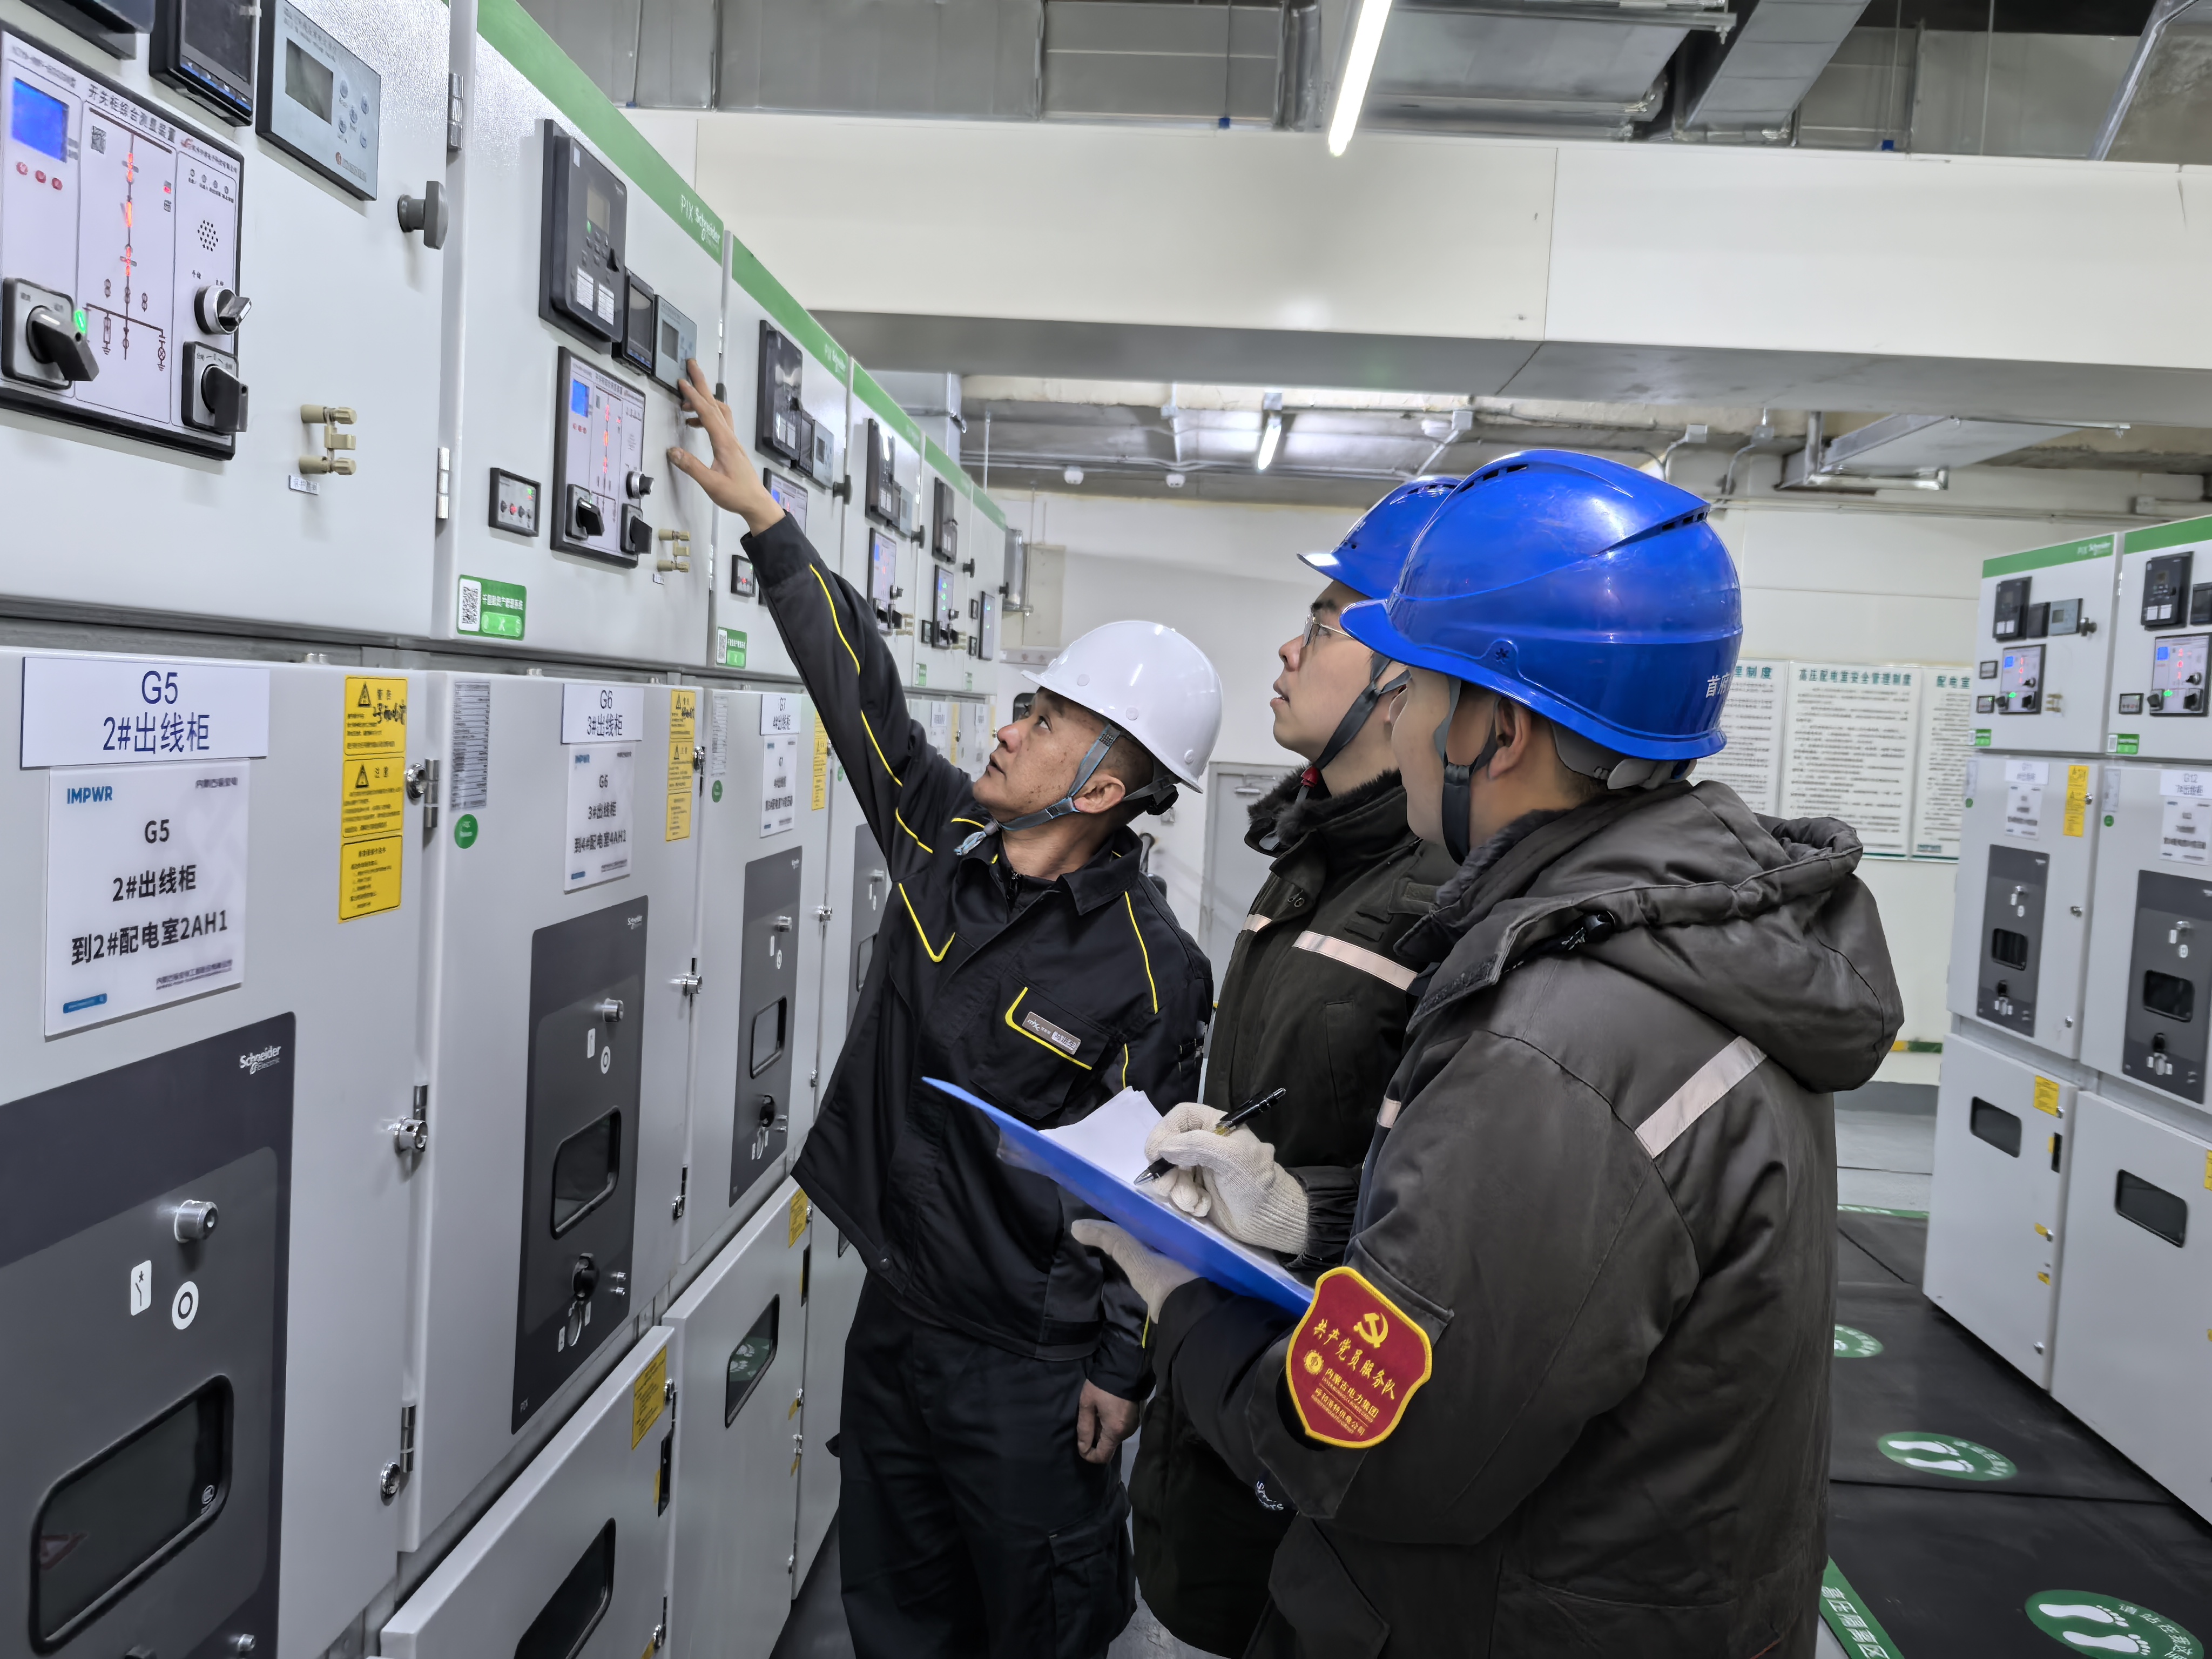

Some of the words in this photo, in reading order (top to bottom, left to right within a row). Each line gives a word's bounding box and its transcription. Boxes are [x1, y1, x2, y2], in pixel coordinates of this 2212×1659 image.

[141, 670, 179, 704] G5
[600, 690, 613, 709] G6
[103, 711, 211, 754] 2#出线柜
[586, 713, 623, 737] 3#出线柜
[66, 786, 113, 804] IMPWR
[145, 819, 170, 844] G5
[112, 864, 198, 902] 2#出线柜
[71, 909, 228, 966] 到2#配电室2AH1
[239, 1045, 281, 1069] Schneider
[1313, 1318, 1395, 1400] 共产党员服务队
[1325, 1367, 1379, 1419] 内蒙古电力集团
